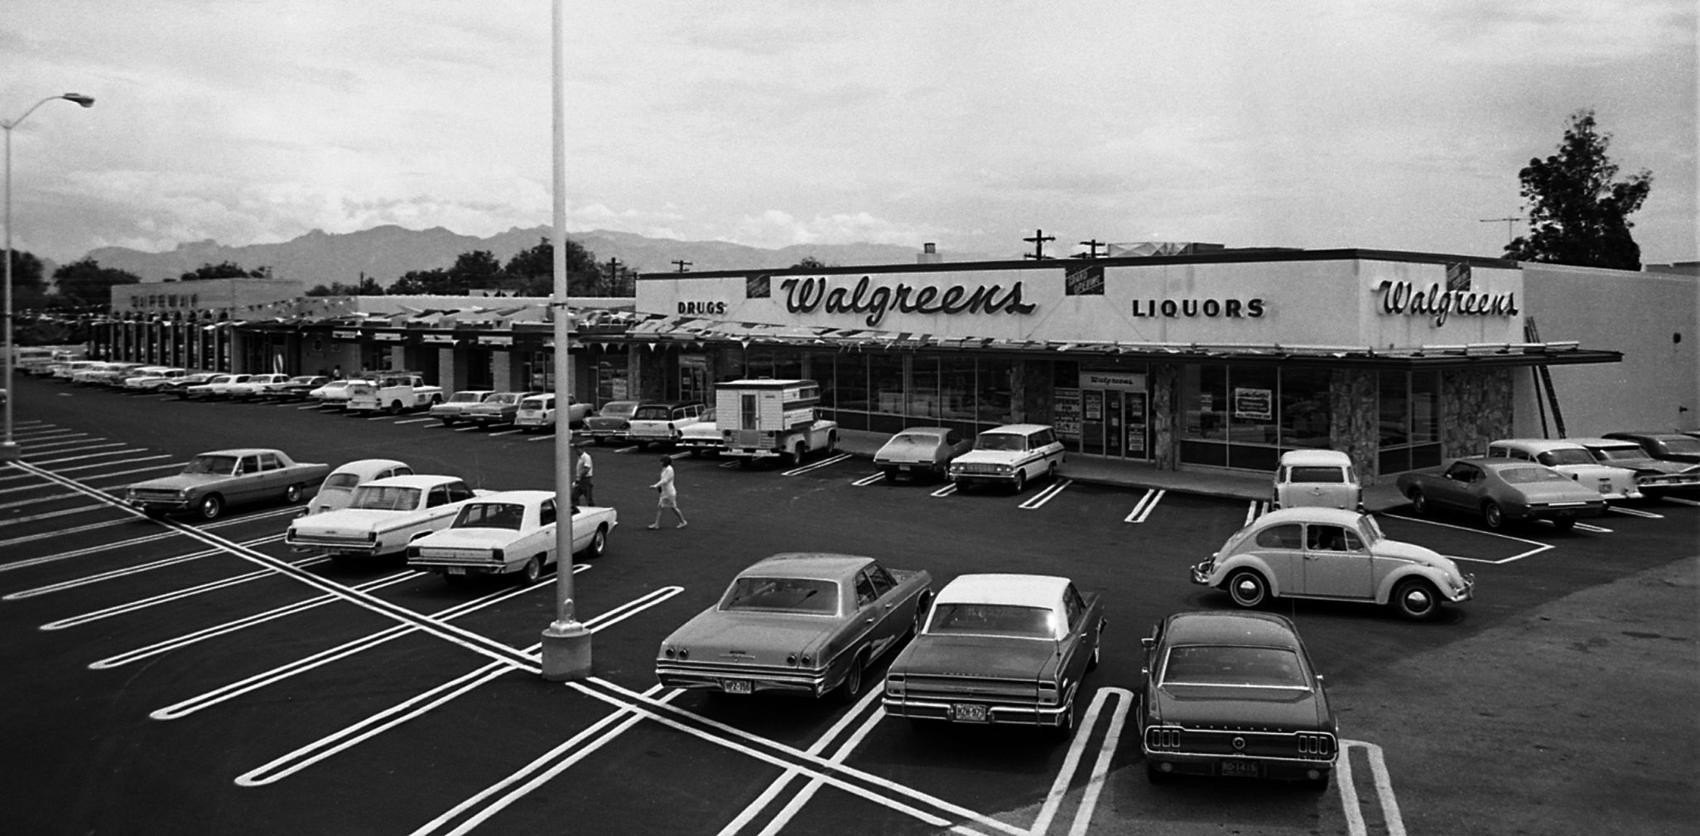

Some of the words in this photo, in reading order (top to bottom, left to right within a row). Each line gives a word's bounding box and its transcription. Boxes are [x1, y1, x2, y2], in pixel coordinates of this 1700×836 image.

[678, 301, 725, 314] DRUGS
[781, 276, 1036, 328] Walgreens
[1131, 299, 1266, 317] LIQUORS
[1377, 280, 1520, 327] Walgreens
[1090, 376, 1133, 386] Walgreens
